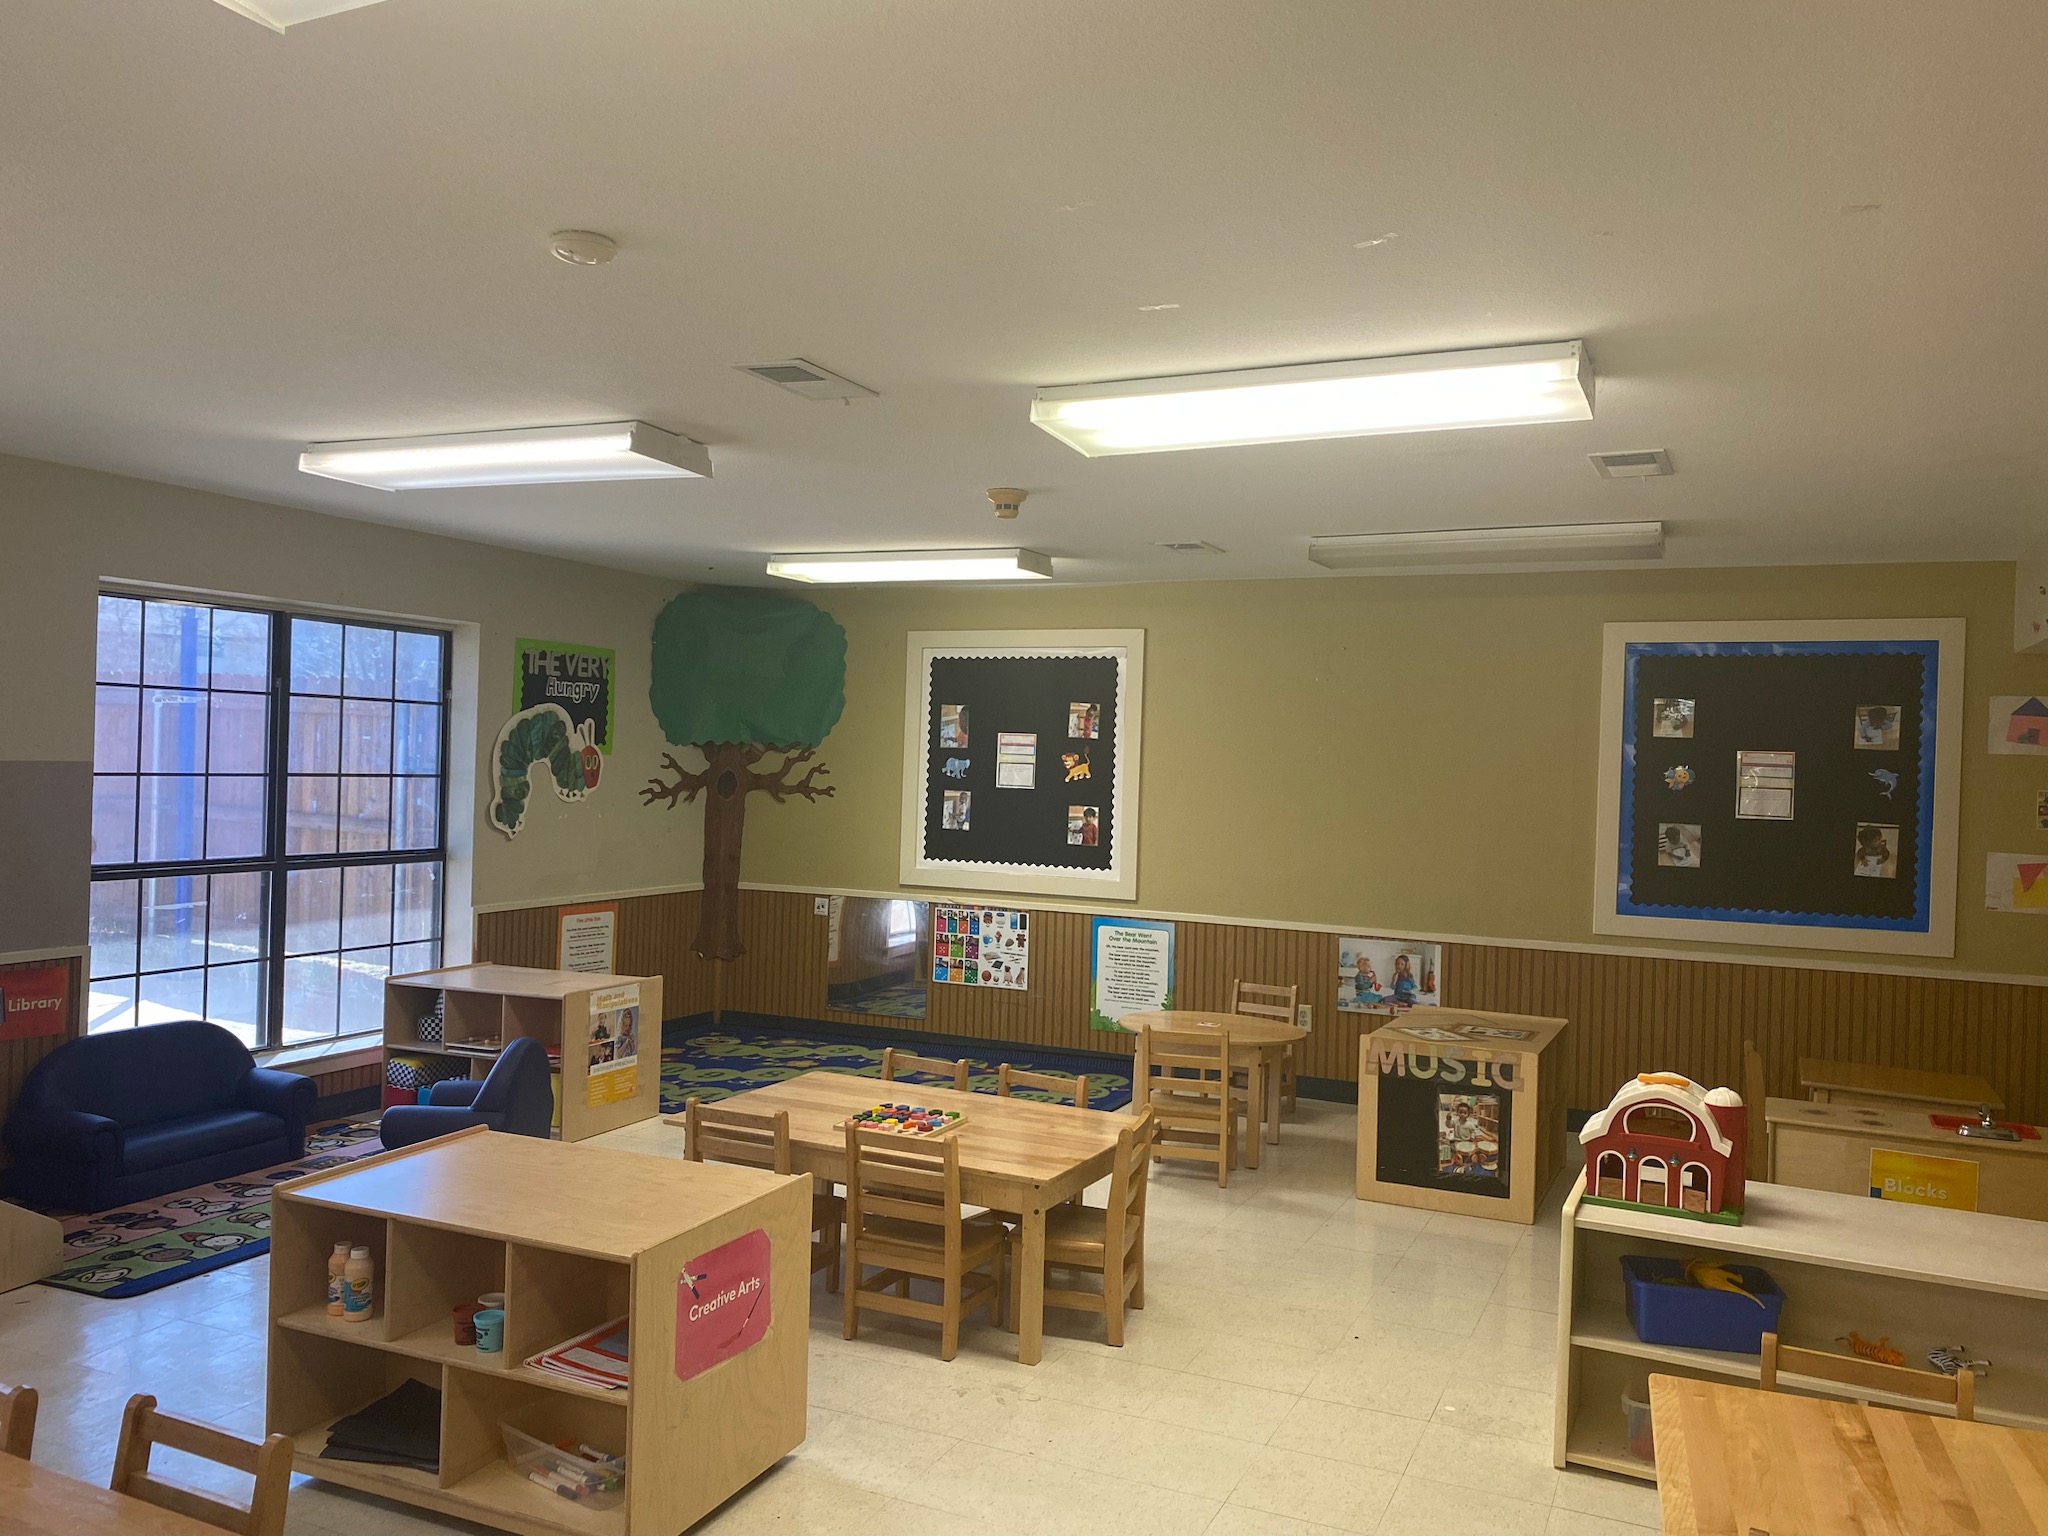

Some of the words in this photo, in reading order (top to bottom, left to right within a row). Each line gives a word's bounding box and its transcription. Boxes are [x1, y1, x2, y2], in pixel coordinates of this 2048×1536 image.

[525, 649, 561, 677] THE
[565, 652, 612, 680] VERY
[546, 676, 600, 704] Hungry
[8, 997, 62, 1012] Library
[1368, 1038, 1522, 1090] MUSIC
[1884, 1177, 1948, 1200] Blocks
[689, 1290, 736, 1321] Creative
[737, 1277, 760, 1298] Arts
